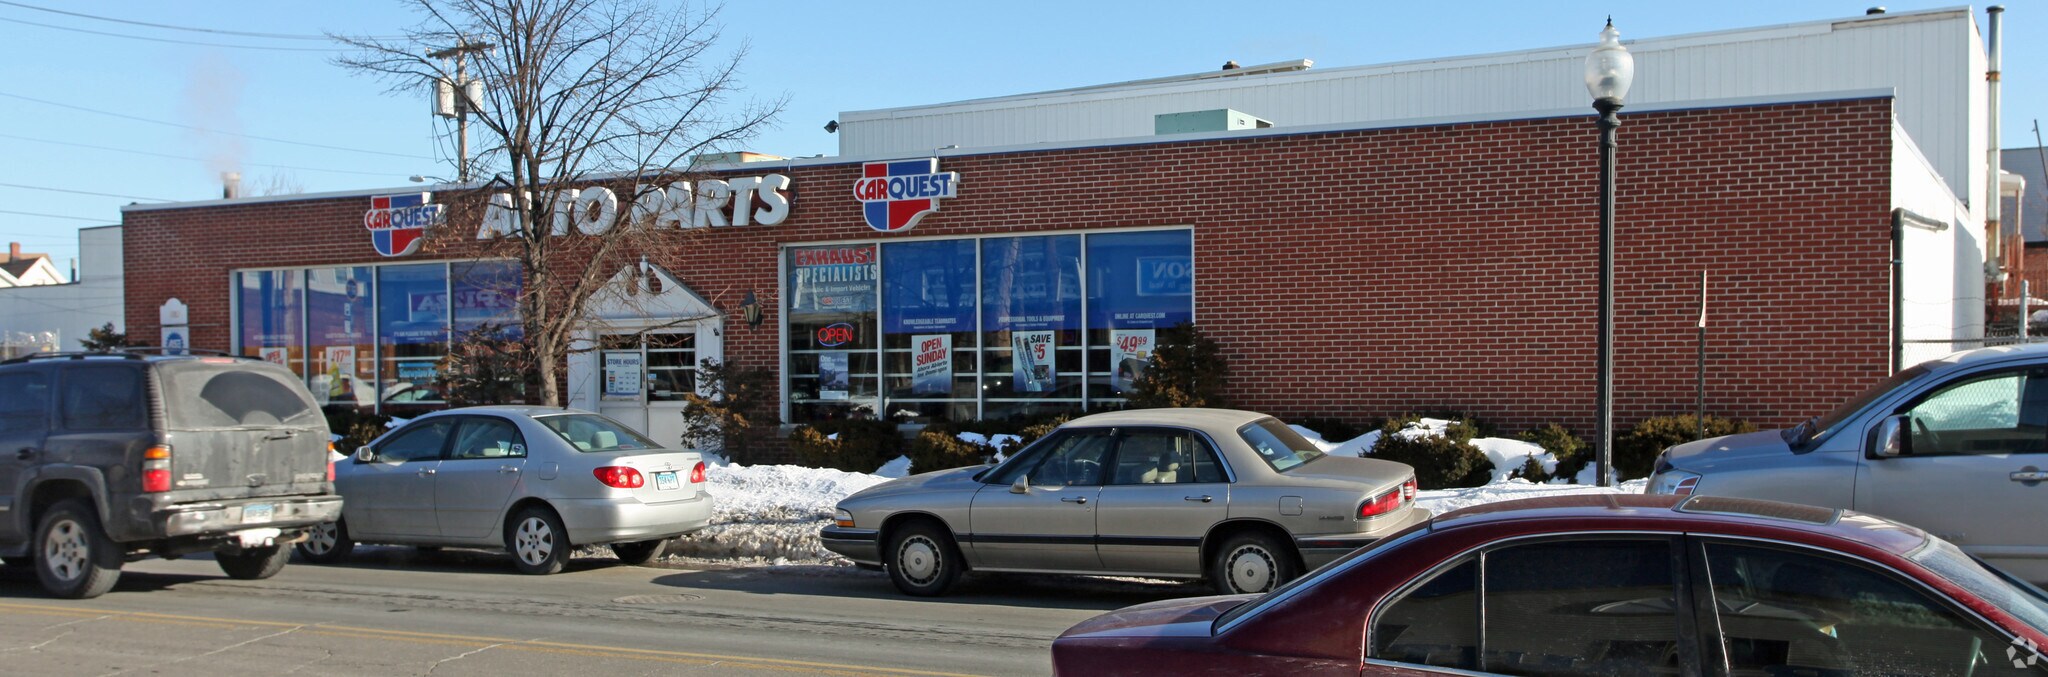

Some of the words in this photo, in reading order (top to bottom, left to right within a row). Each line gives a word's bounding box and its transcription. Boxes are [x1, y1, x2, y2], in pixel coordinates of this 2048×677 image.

[856, 174, 951, 200] CARQUEST
[630, 173, 791, 231] PARTS
[367, 206, 437, 229] CARQUEST
[795, 245, 876, 266] EXHAUST
[796, 265, 877, 282] SPECIALISTS
[848, 284, 871, 292] Vehicles
[817, 327, 853, 342] OPEN
[1030, 334, 1052, 344] SAVE
[921, 337, 942, 353] OPEN
[1034, 344, 1046, 360] $5
[607, 358, 622, 366] STORE
[623, 358, 640, 366] HOURS
[916, 347, 947, 366] SUNDAY
